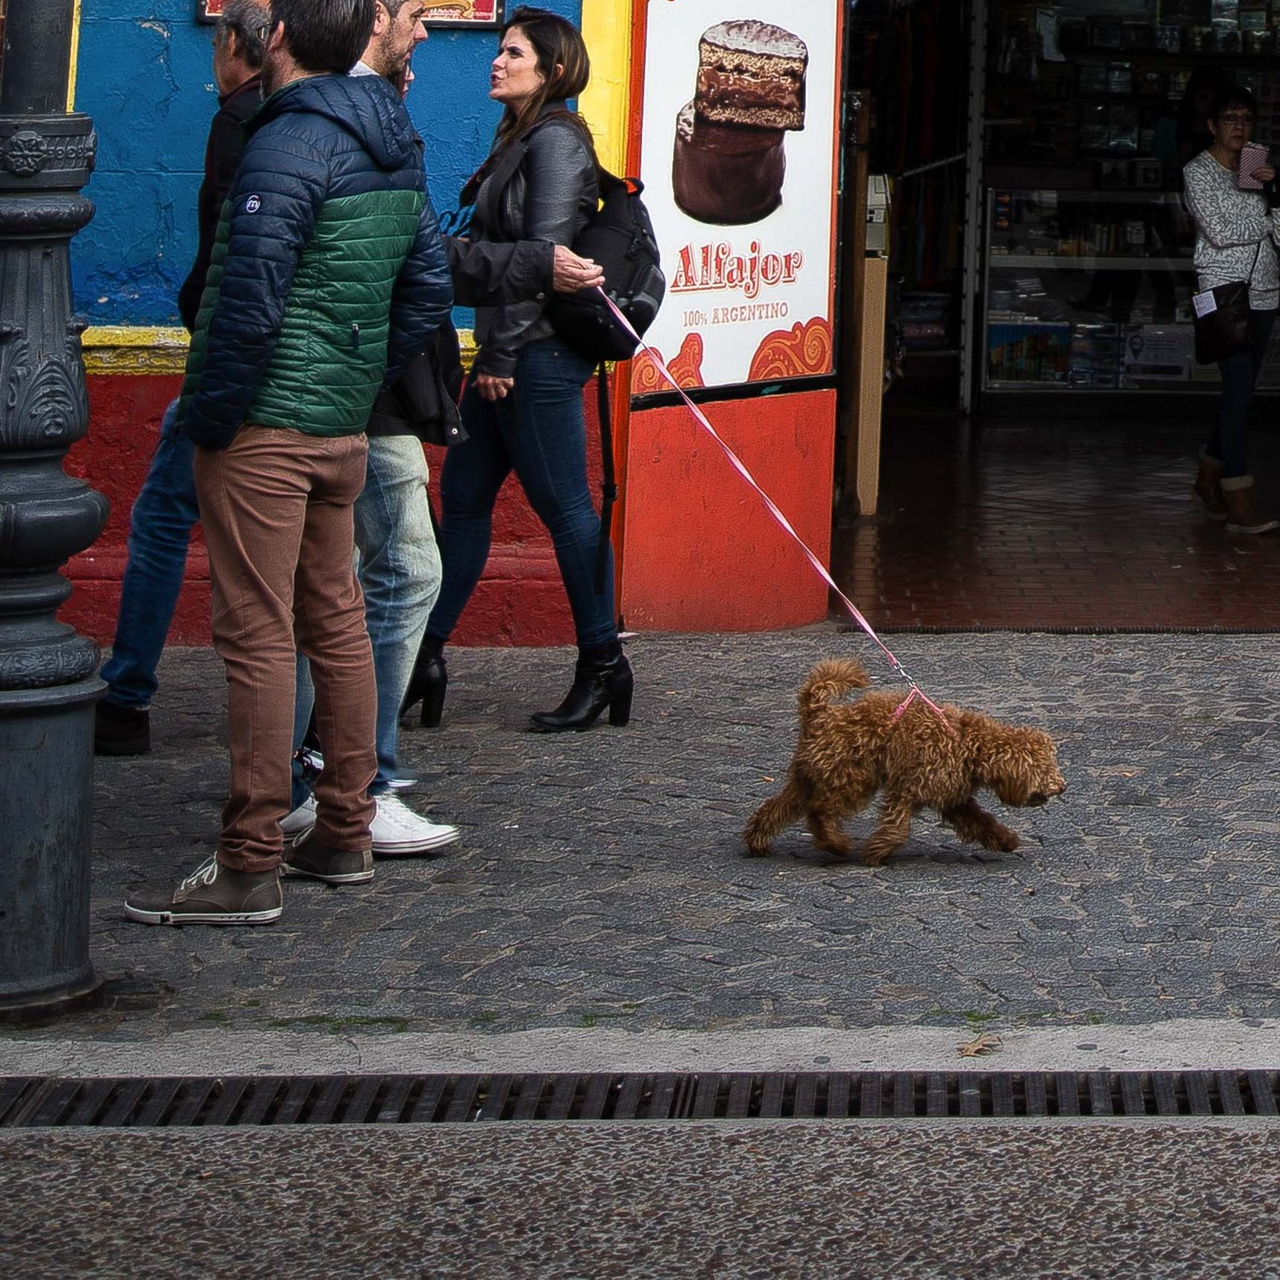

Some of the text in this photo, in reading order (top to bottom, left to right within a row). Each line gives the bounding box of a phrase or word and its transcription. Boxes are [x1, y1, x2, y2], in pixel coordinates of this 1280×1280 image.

[670, 239, 804, 298] Alfajor
[683, 301, 789, 328] 100% ARGENTINO
